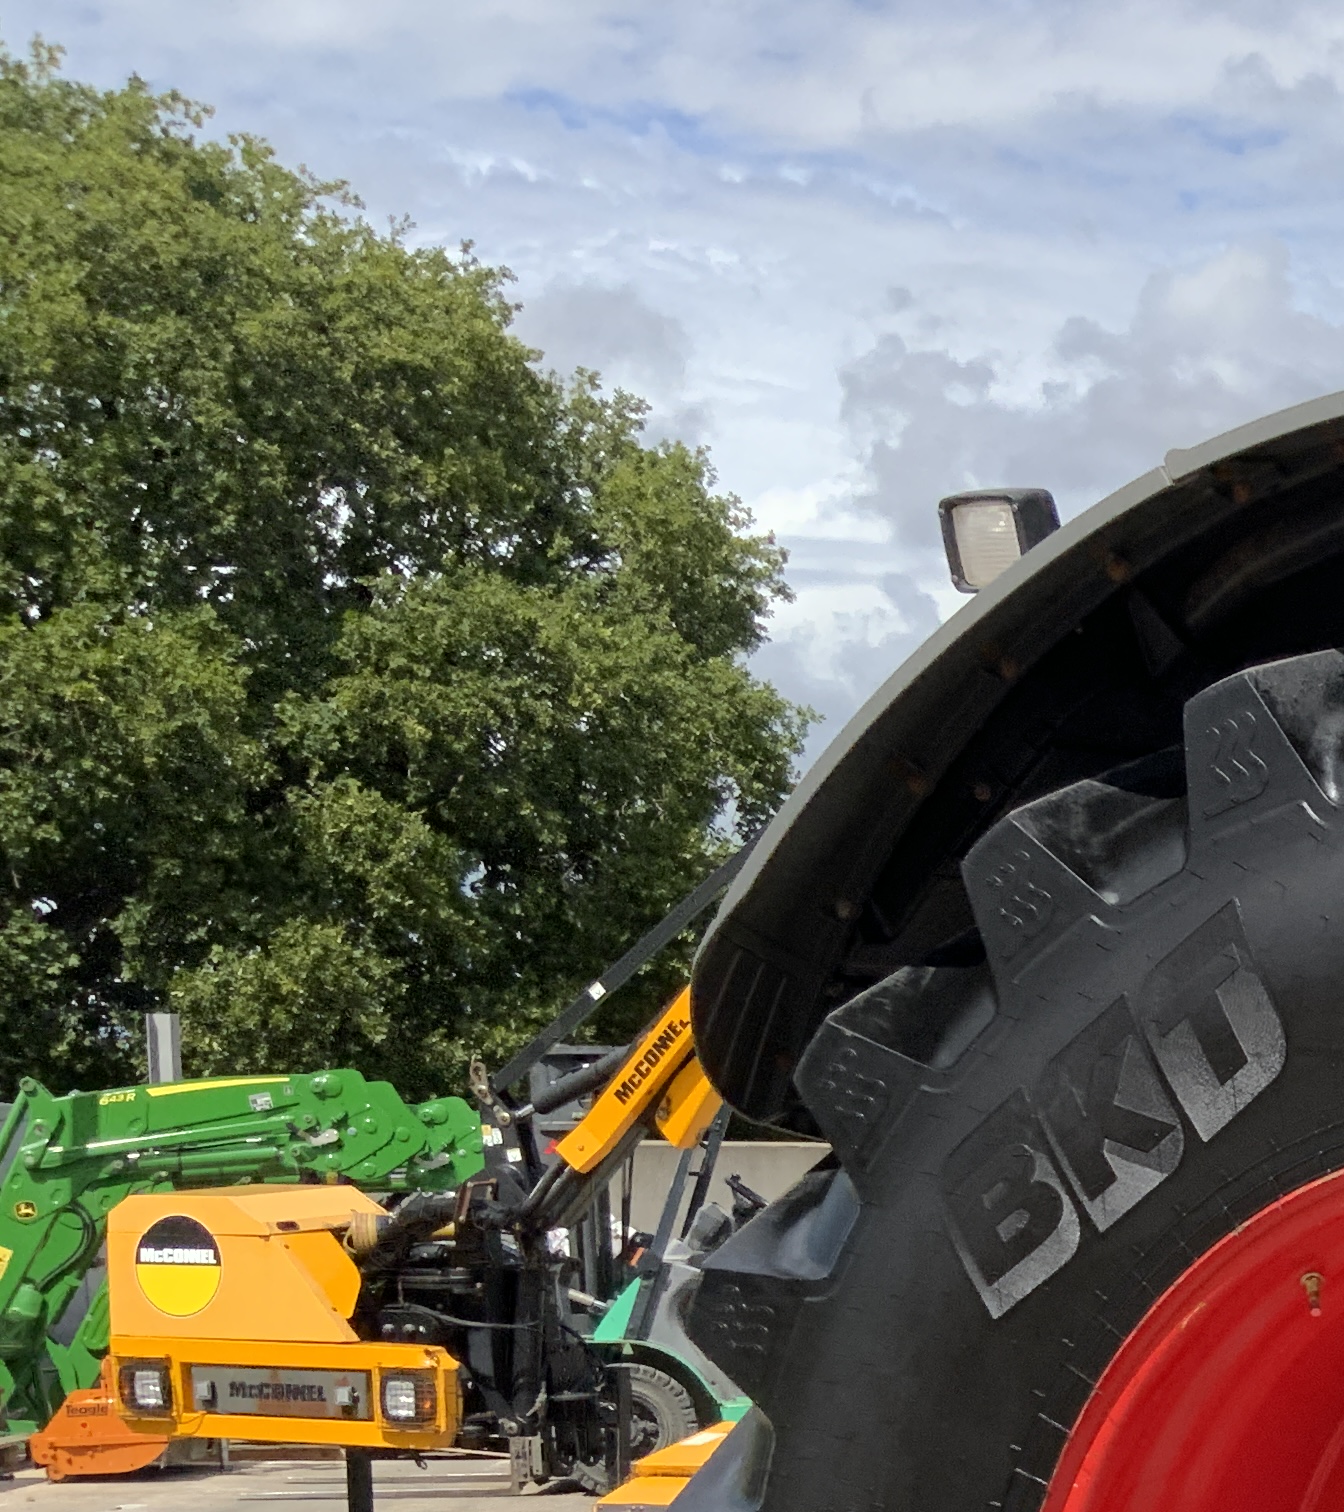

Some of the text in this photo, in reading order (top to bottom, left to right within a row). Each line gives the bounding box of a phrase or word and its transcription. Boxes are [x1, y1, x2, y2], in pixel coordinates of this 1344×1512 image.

[938, 897, 1287, 1319] BKT
[140, 1248, 217, 1264] McCONNEL
[229, 1381, 327, 1402] McCONNEL
